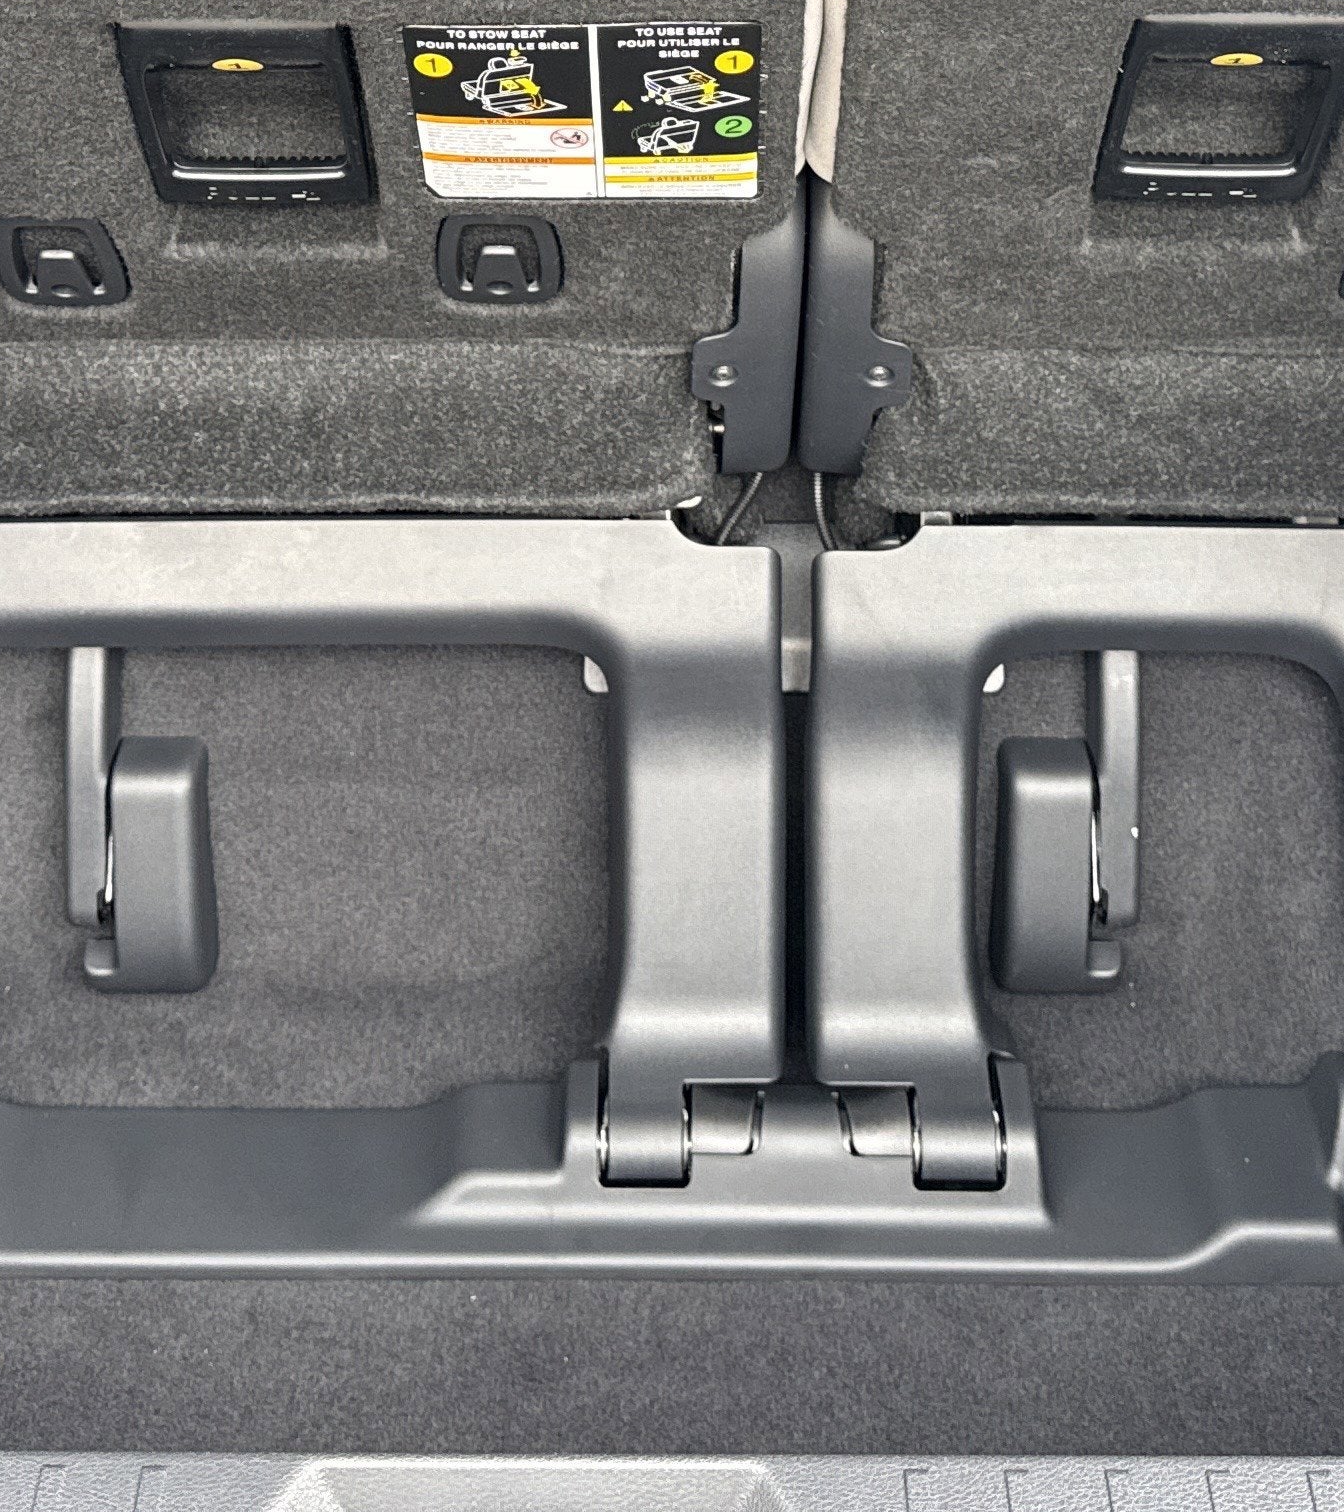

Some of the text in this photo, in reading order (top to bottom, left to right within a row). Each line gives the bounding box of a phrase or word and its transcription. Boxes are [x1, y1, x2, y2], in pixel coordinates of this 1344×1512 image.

[446, 30, 546, 39] TO STOW SEAT
[635, 27, 722, 37] TO USE SEAT
[416, 40, 455, 50] POUR
[457, 41, 516, 51] RANGER
[518, 42, 535, 50] LE
[617, 38, 740, 48] POUR UTILISER LE
[658, 49, 699, 58] SIÈGE
[425, 58, 437, 73] 1
[726, 55, 737, 69] 1
[724, 119, 743, 134] 2
